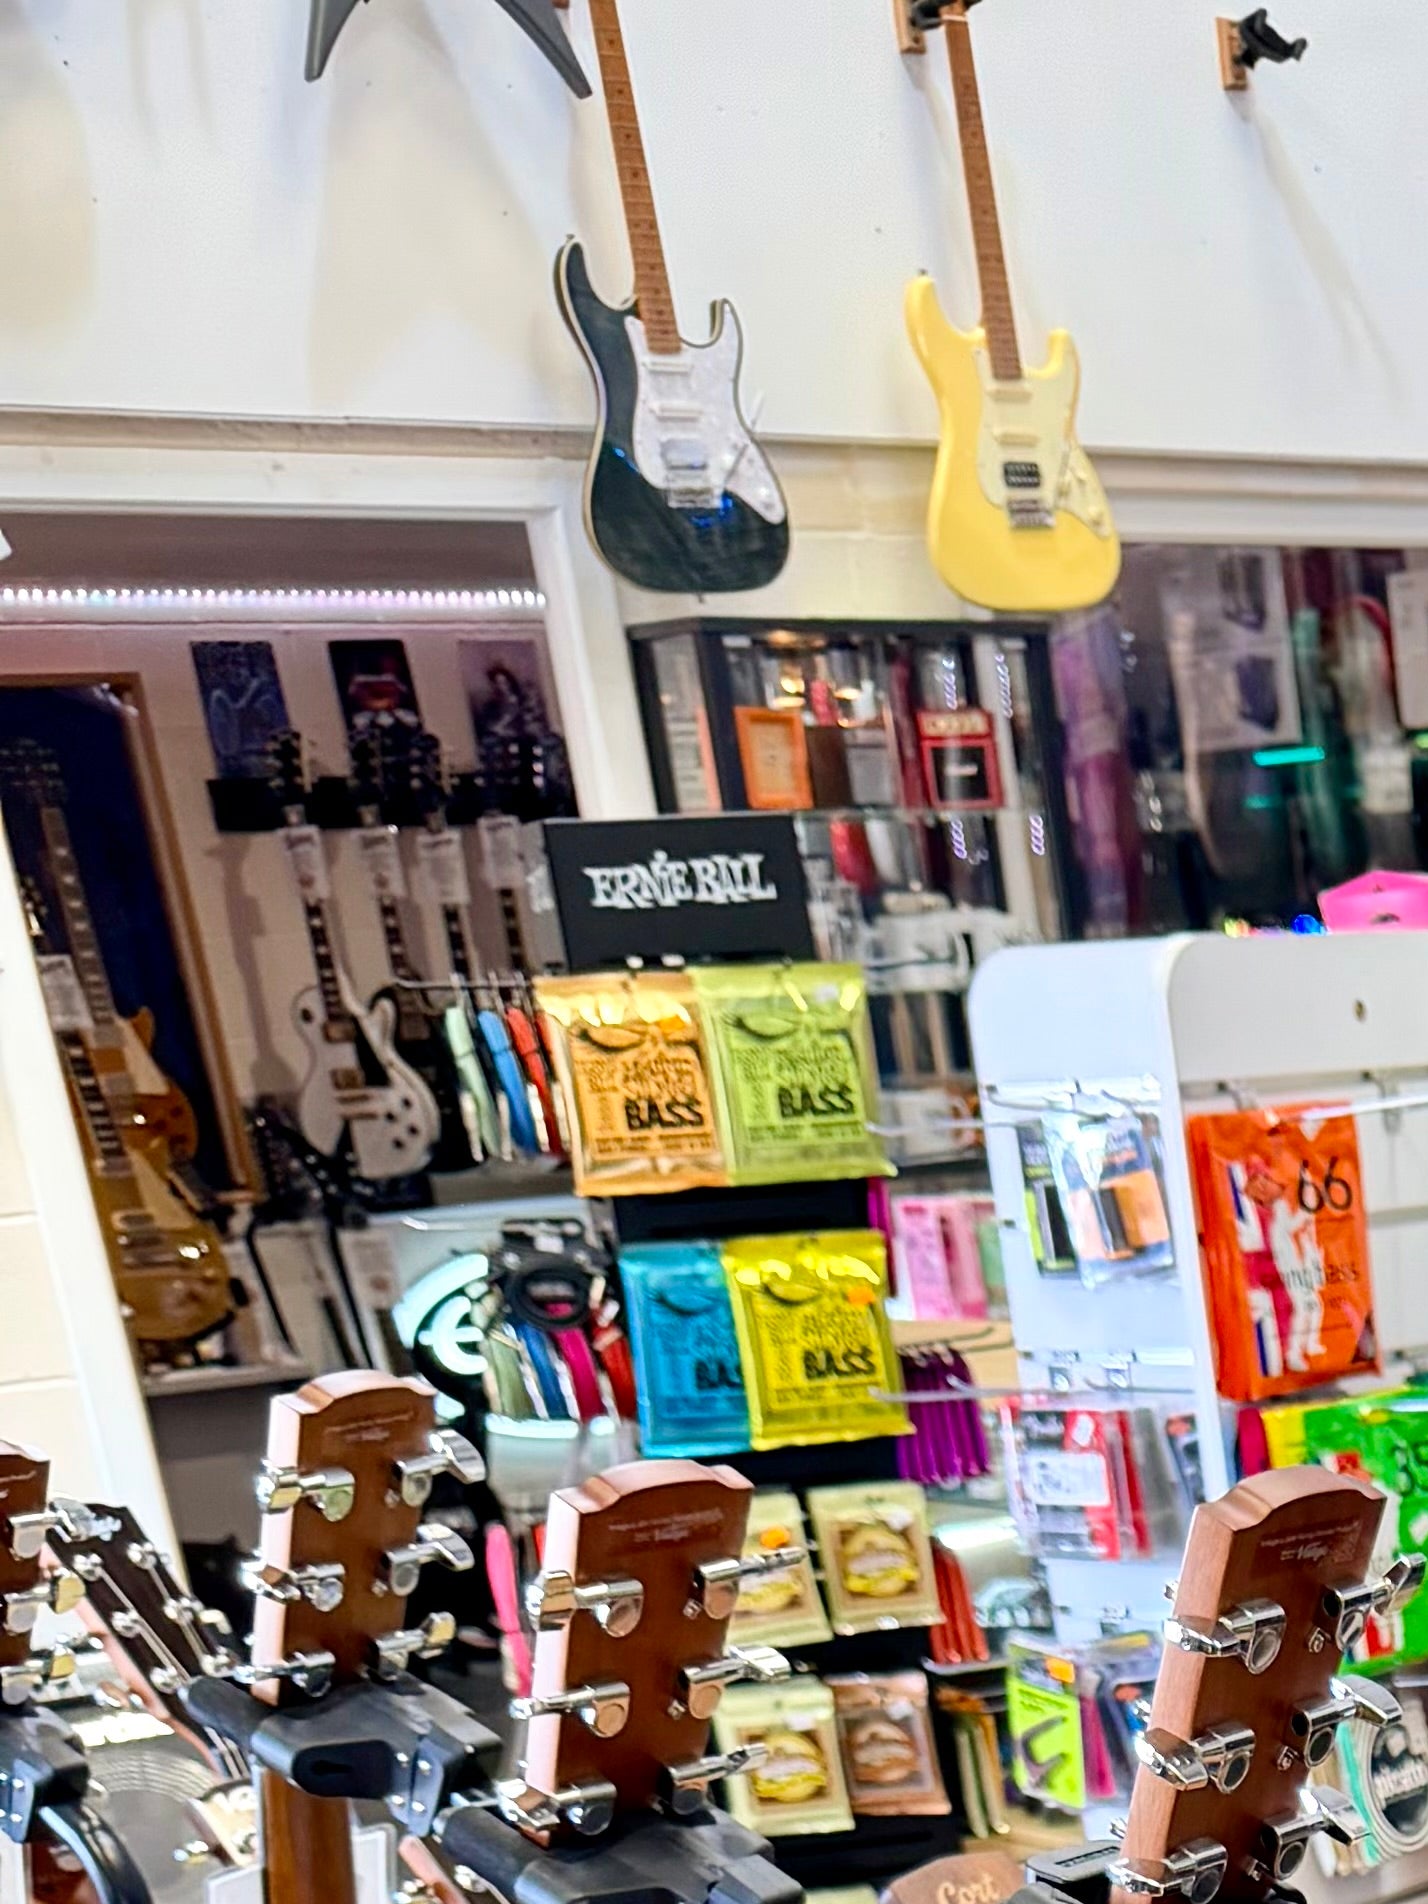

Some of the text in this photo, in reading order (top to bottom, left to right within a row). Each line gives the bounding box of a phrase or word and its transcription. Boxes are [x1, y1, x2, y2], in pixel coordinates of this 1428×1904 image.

[584, 850, 777, 911] ERNIE BALL
[624, 1099, 704, 1130] BASS
[777, 1085, 856, 1117] BASS
[1297, 1155, 1353, 1214] 66
[695, 1358, 745, 1389] BA
[803, 1347, 876, 1380] BASS
